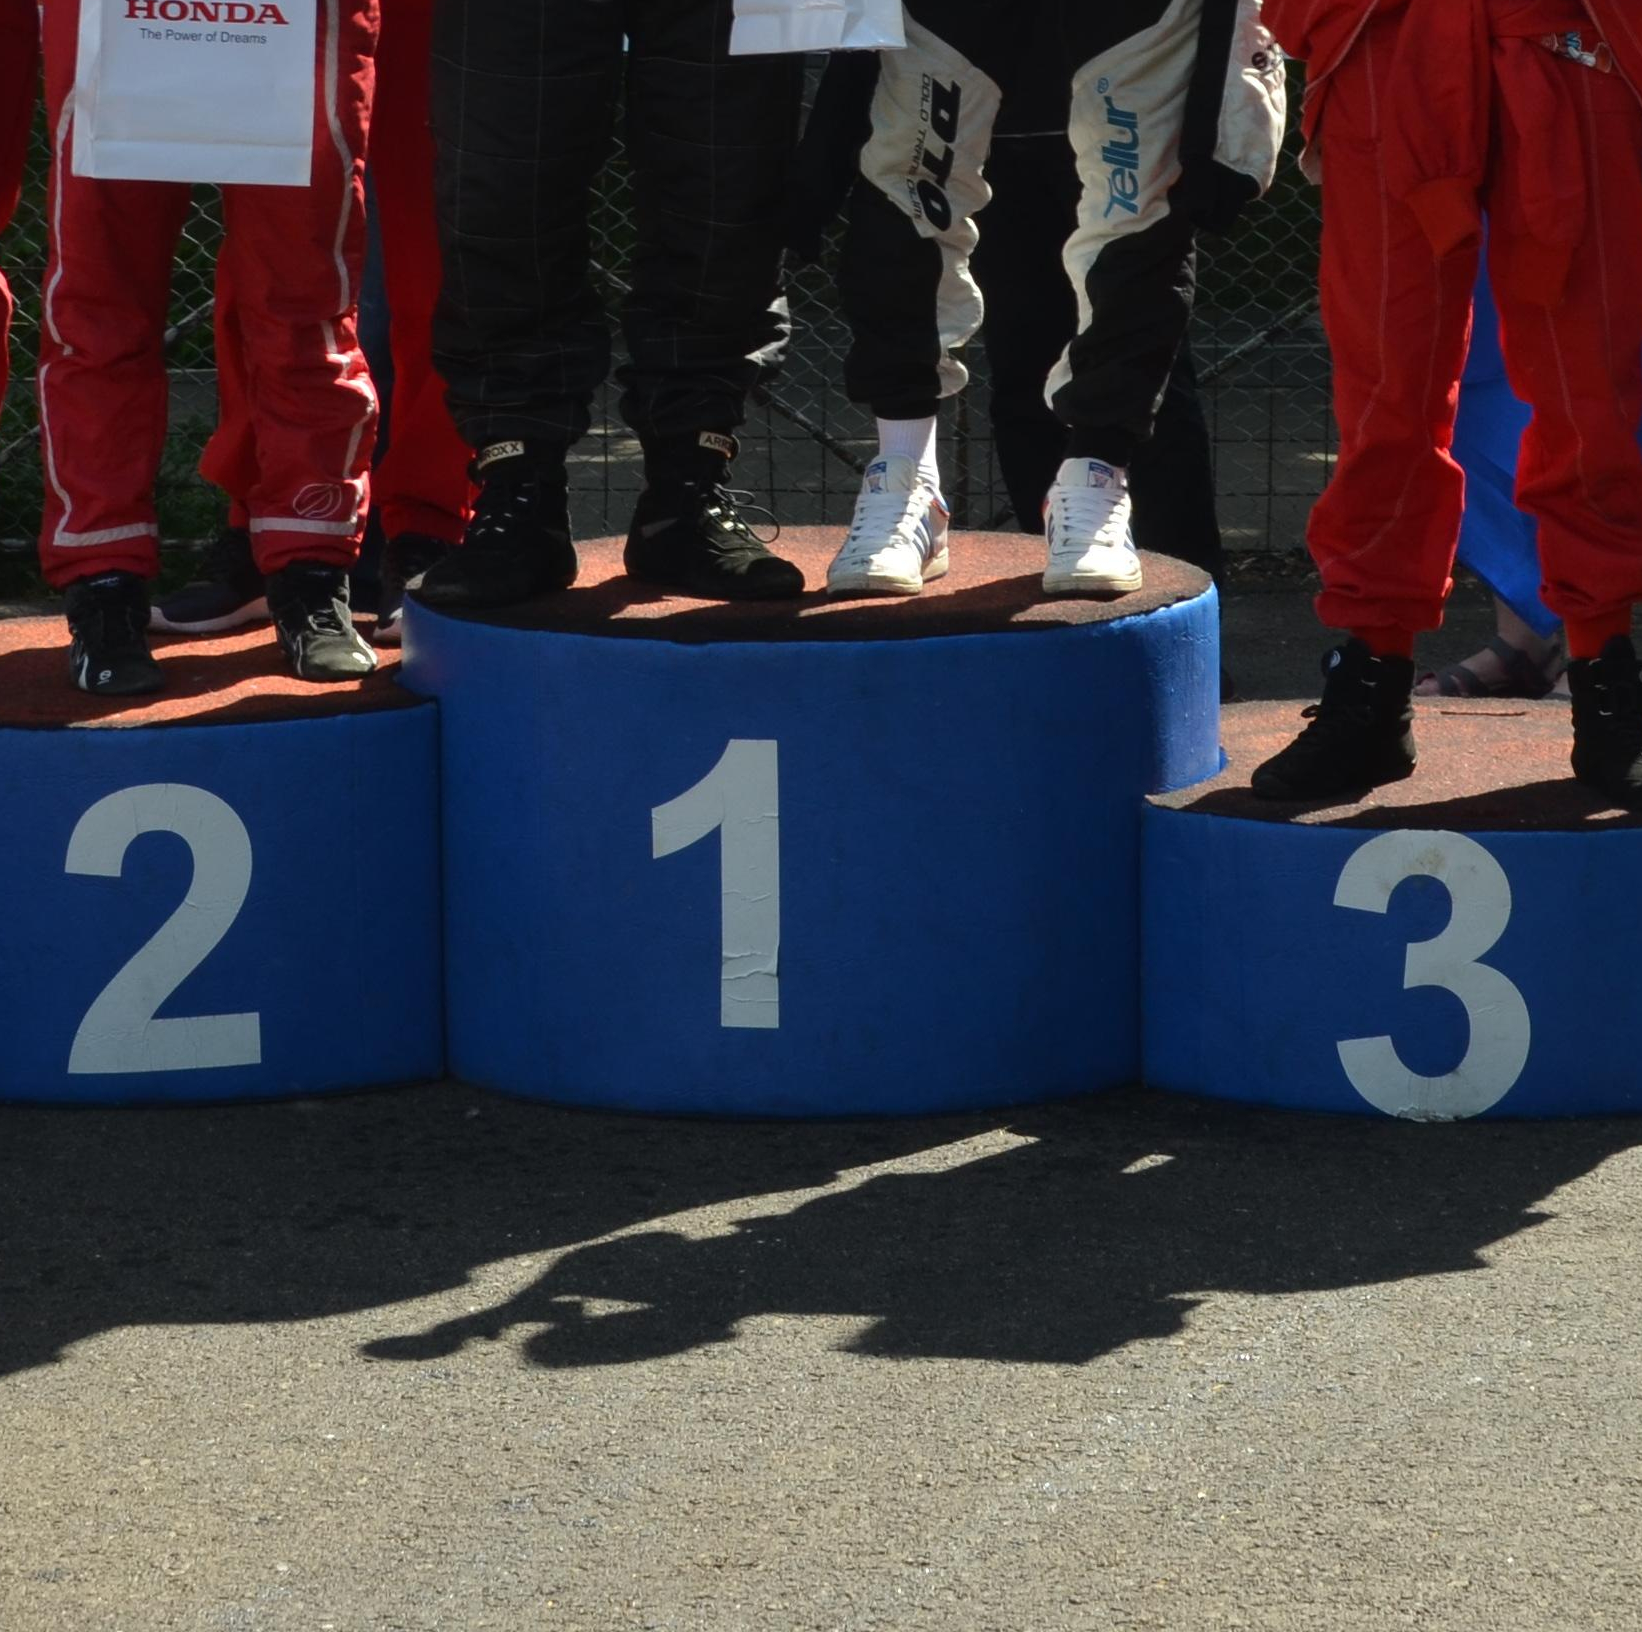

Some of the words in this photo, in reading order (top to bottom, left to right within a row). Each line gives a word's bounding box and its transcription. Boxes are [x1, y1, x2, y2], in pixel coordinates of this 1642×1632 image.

[140, 27, 162, 40] The
[165, 29, 203, 41] Power
[205, 30, 218, 42] of
[220, 31, 268, 44] Dreams
[916, 77, 962, 232] DTO
[1101, 95, 1140, 218] Tellur
[64, 782, 262, 1075] 2
[650, 738, 781, 1030] 1
[1332, 828, 1532, 1123] 3
